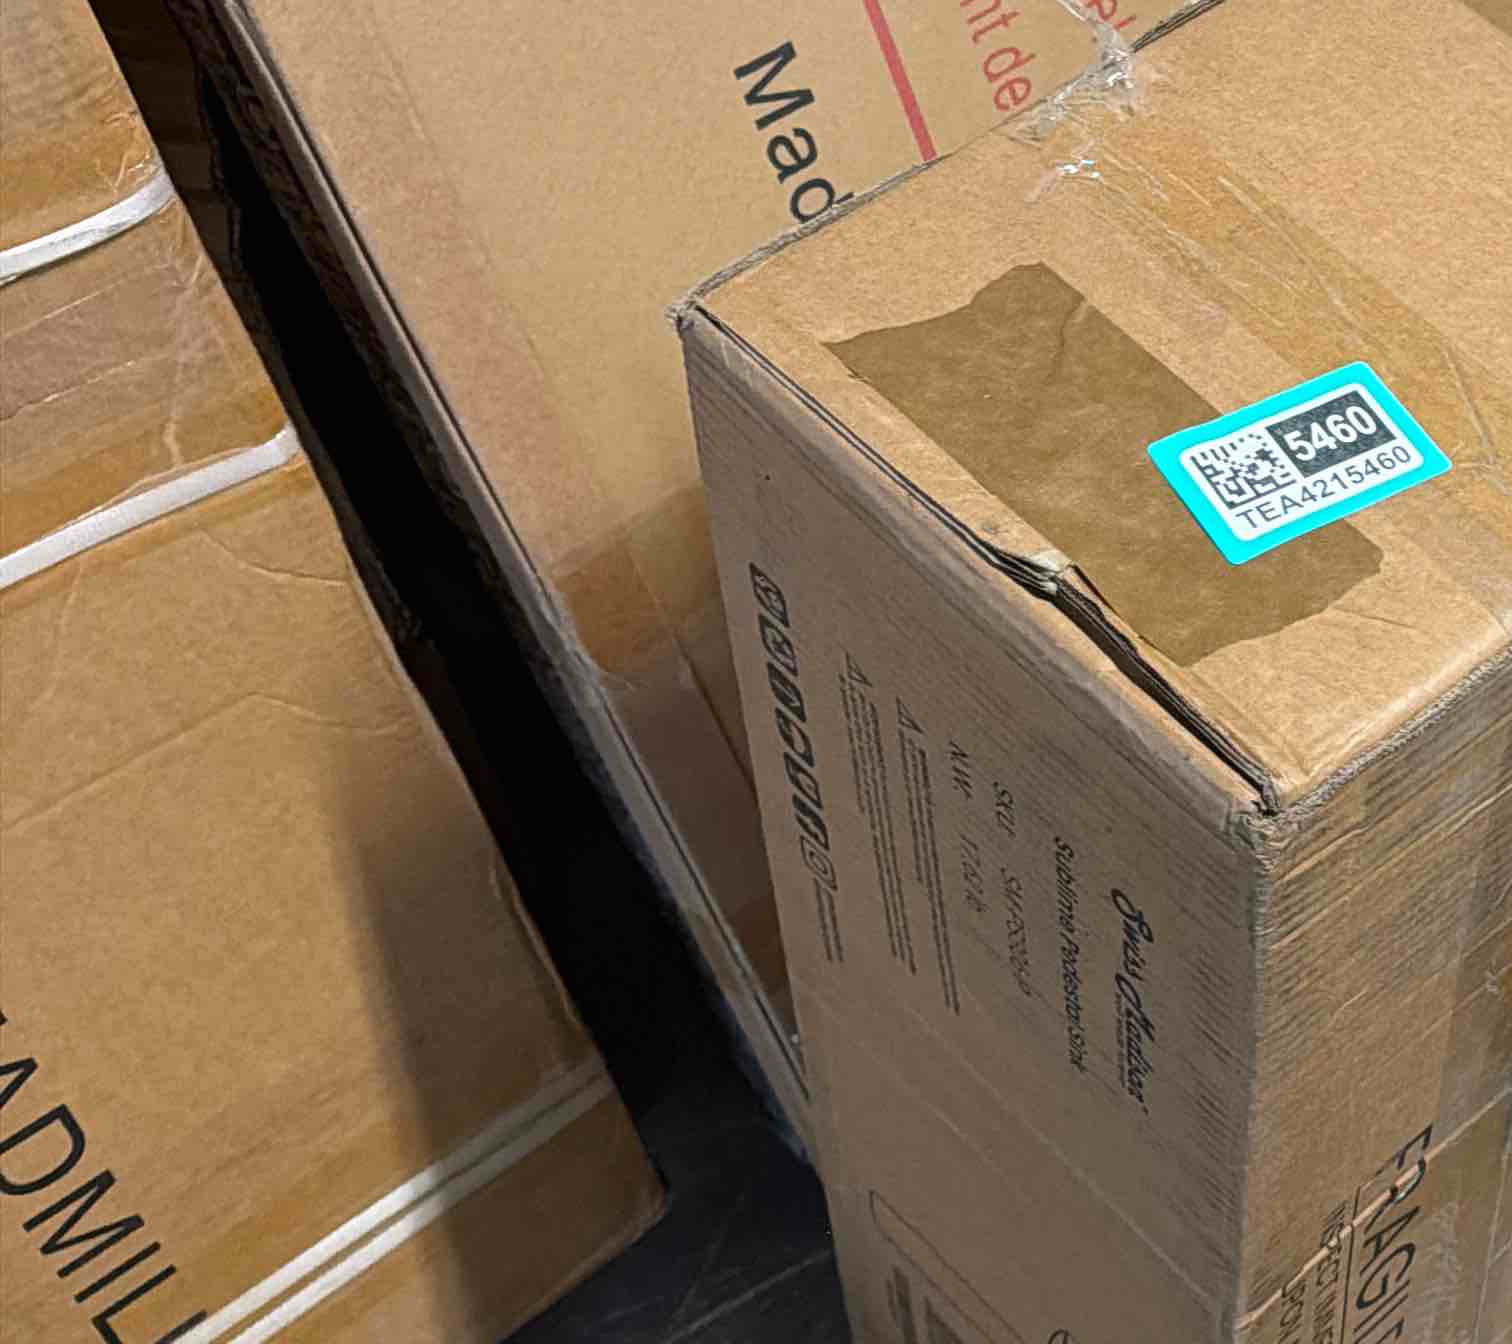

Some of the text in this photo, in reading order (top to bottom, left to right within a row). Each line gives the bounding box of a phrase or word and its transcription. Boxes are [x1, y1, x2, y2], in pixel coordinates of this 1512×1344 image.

[1284, 405, 1377, 462] 5460
[1236, 445, 1411, 529] TEA4215460
[1055, 839, 1077, 937] Sublime
[1111, 889, 1154, 1106] Swiss Madison
